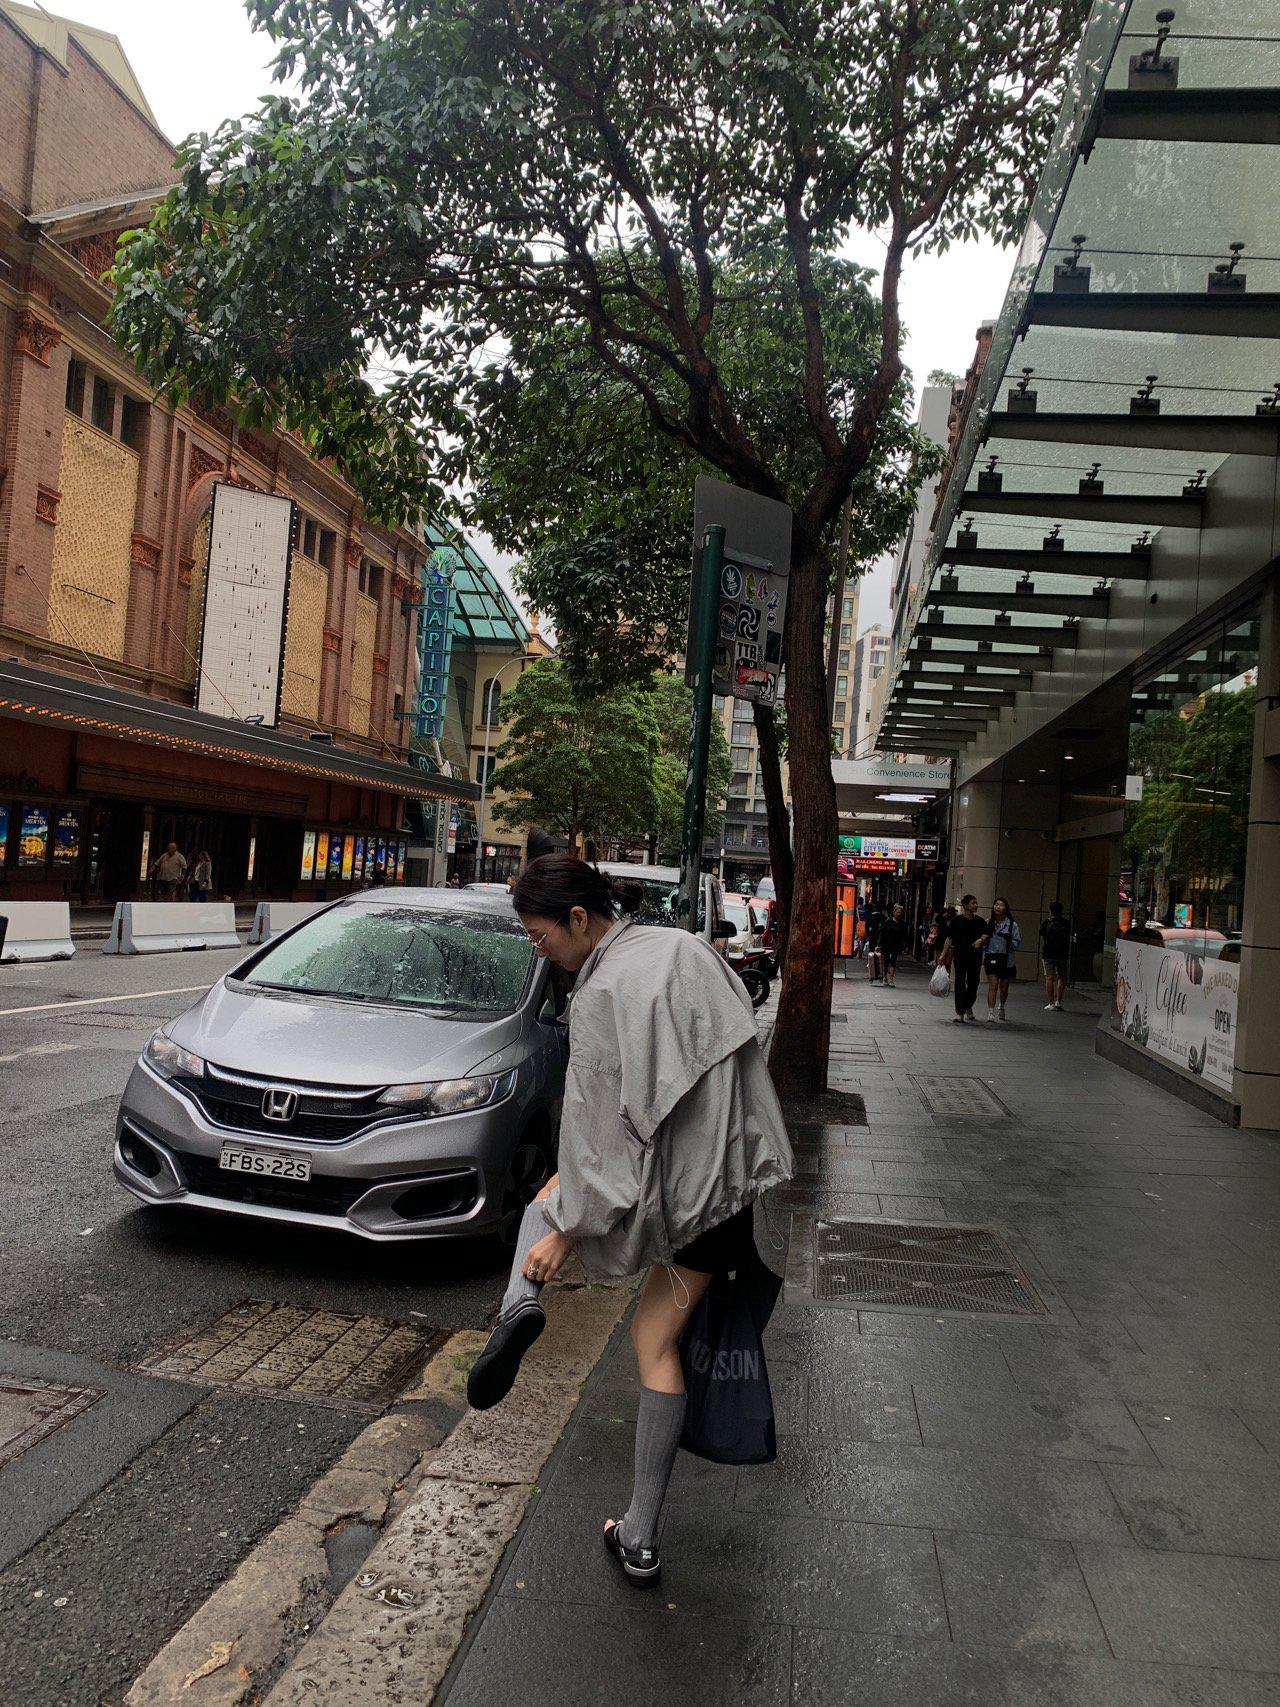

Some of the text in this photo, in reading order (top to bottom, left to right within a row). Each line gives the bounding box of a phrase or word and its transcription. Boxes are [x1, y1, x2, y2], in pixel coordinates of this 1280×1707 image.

[421, 588, 444, 736] CAPITOL
[738, 641, 757, 660] TTB
[866, 767, 926, 779] Convenience
[863, 845, 877, 853] CITY
[1155, 955, 1188, 1034] Coffee
[1215, 1008, 1232, 1035] OPEN
